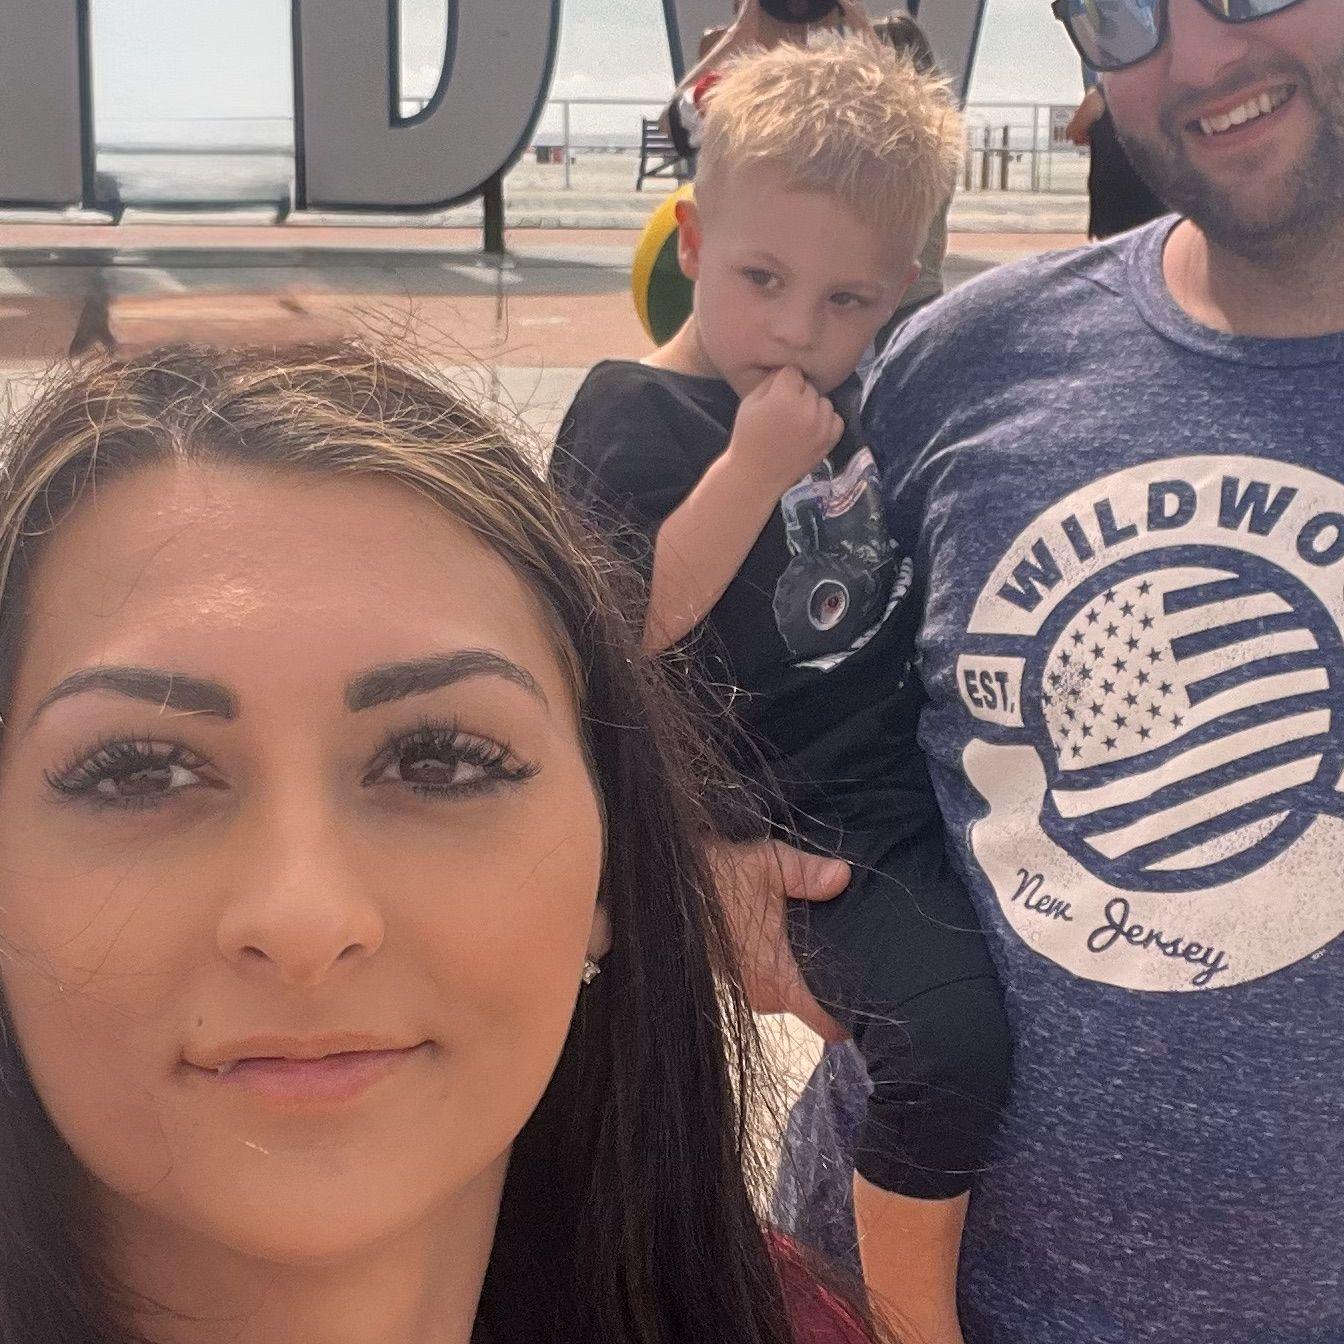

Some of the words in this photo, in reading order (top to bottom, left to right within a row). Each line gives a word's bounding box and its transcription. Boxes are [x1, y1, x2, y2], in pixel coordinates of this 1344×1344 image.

[963, 669, 1015, 714] EST.
[1010, 867, 1074, 922] New
[1086, 897, 1230, 987] Jersey
